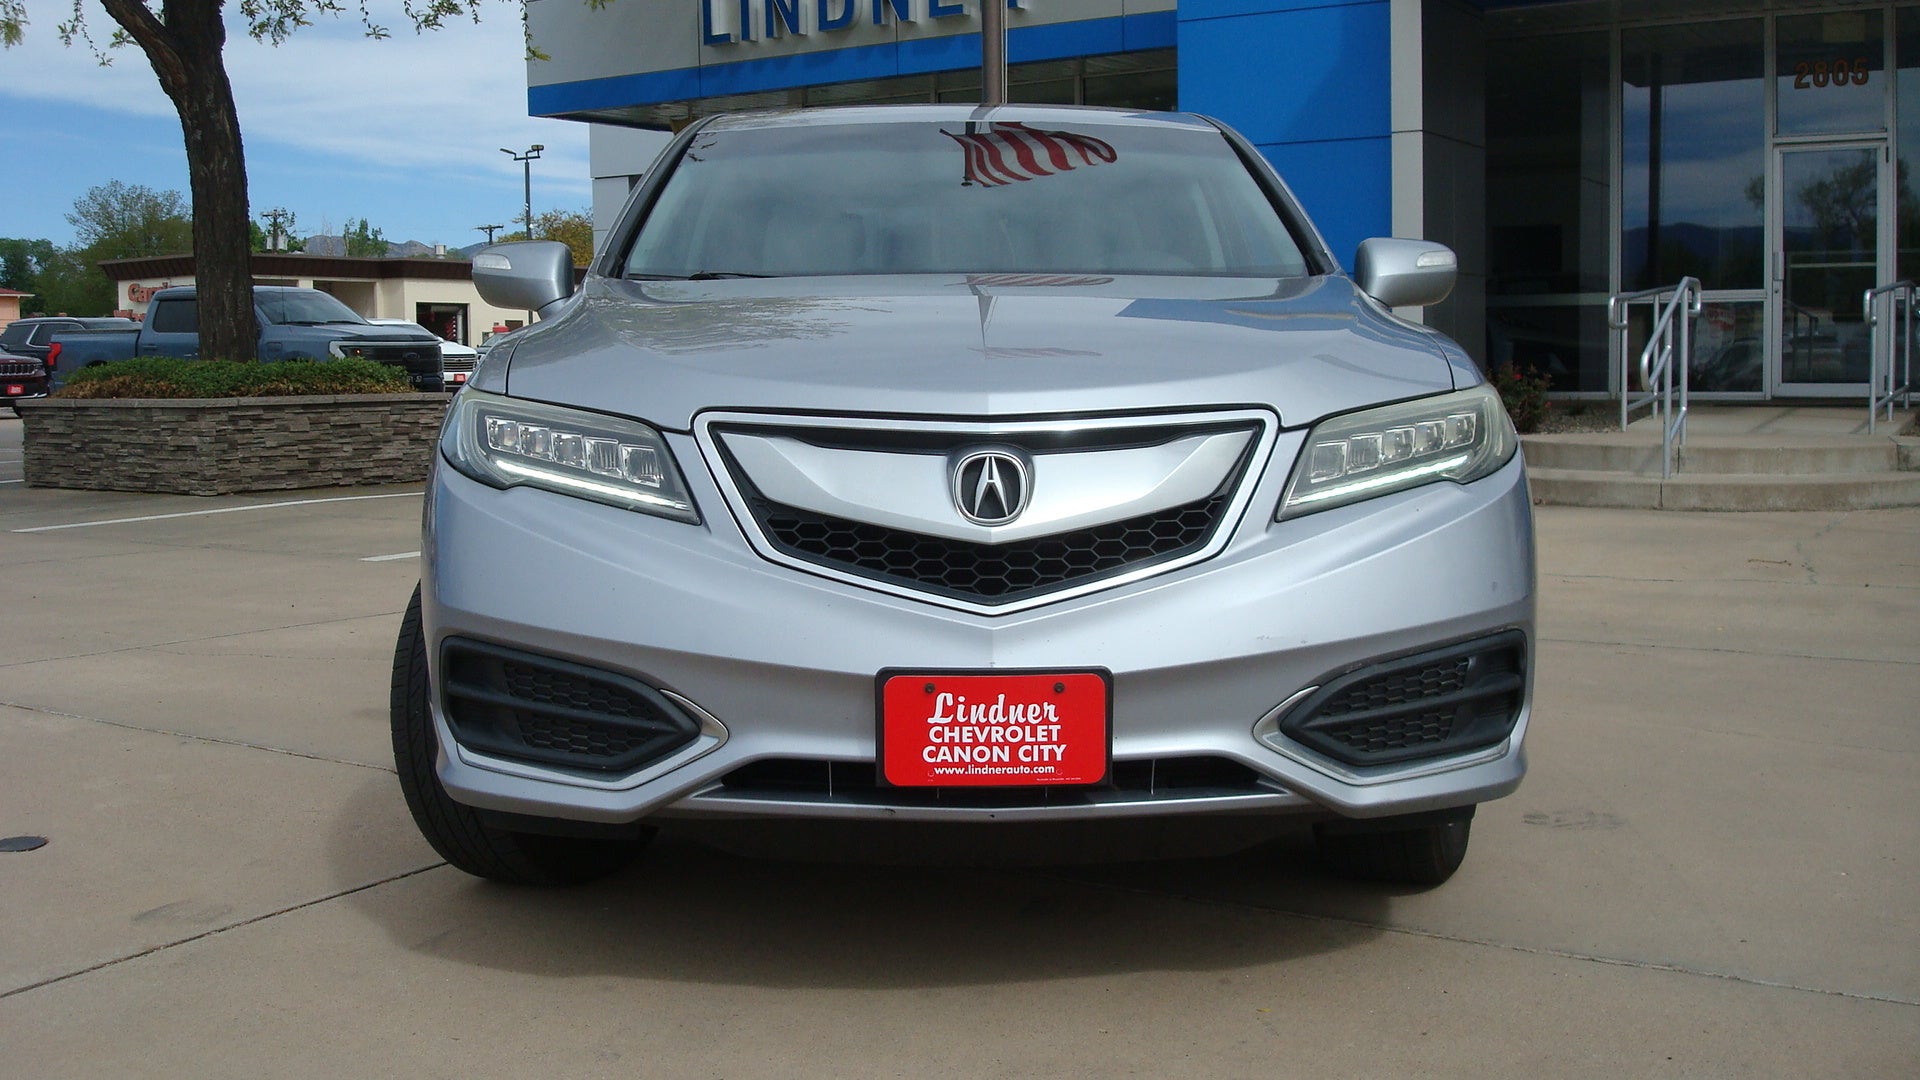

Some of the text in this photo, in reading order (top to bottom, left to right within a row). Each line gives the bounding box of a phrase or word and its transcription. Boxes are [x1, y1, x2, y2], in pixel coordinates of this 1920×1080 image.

[703, 0, 1025, 46] LINDN
[1793, 57, 1869, 89] 2805
[927, 692, 1059, 725] Lindner
[928, 725, 1061, 743] CHEVROLET
[922, 744, 1067, 763] CANON CITY
[934, 764, 1055, 775] www.lindnerauto.com
